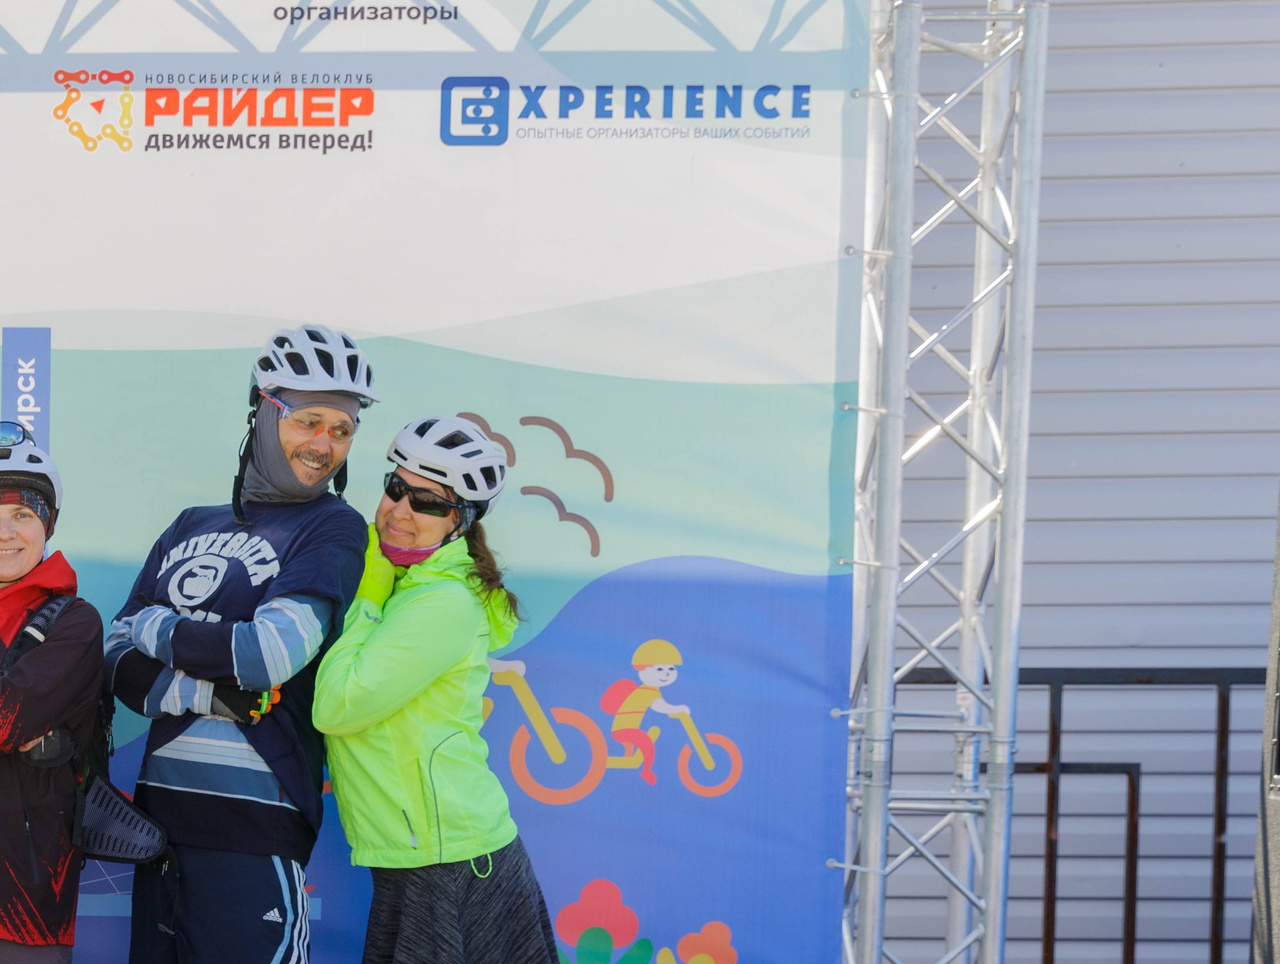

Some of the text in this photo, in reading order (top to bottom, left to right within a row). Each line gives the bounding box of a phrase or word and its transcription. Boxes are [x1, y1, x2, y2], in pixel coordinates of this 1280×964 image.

[273, 3, 459, 25] организаторы
[145, 72, 374, 85] НОВОСИБИРСКИЙ ВЕЛОКЛУБ
[144, 87, 375, 128] РАЙДЕР
[144, 130, 374, 155] движемся вперед!
[516, 125, 811, 140] ОПЫТНЫЕ ОРГАНИЗАТОРЫ ВАШИХ СОБЫТИЙ
